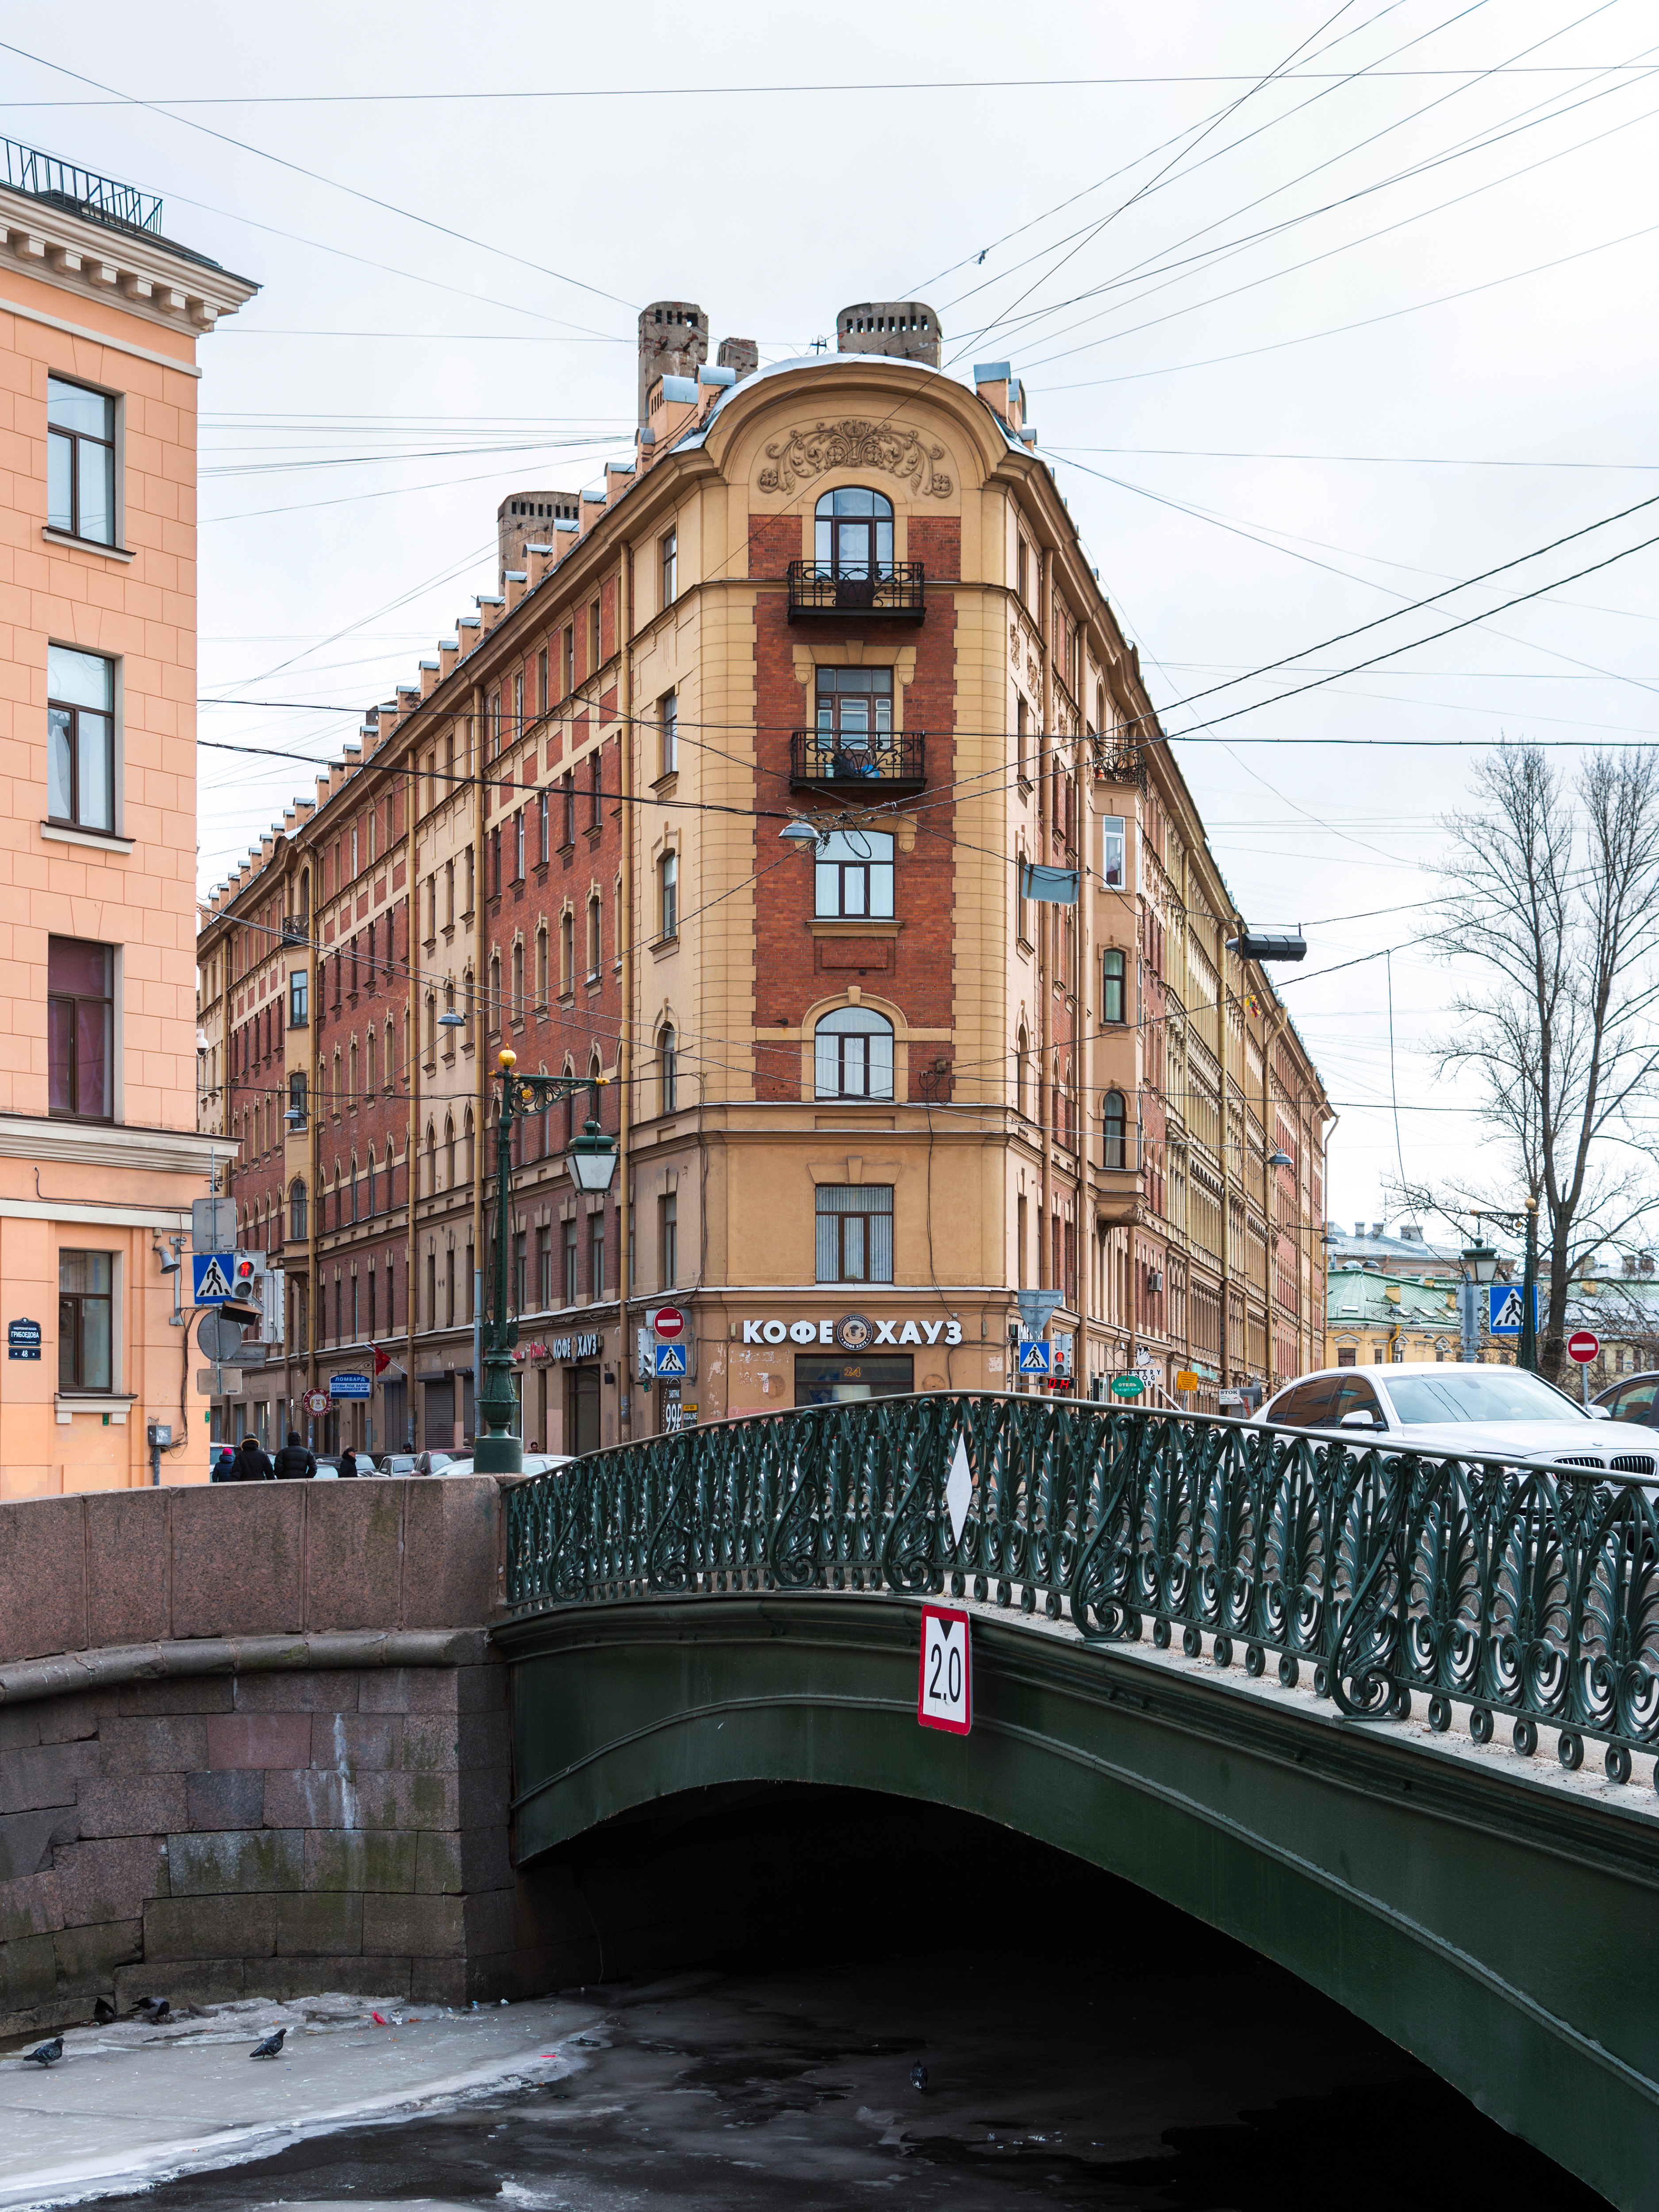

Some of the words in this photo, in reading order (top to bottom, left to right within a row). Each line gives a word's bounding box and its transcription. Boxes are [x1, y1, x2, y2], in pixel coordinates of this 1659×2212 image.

[743, 1320, 834, 1344] КОФЕ
[873, 1320, 963, 1344] ХАУЗ
[553, 1338, 571, 1359] КОФЕ
[577, 1334, 597, 1357] ХАУЗ
[844, 1367, 861, 1378] 24
[306, 1389, 330, 1398] КАФЕ
[304, 1401, 332, 1417] КОНДИТЕРСКАЯ
[929, 1644, 961, 1702] 2.0
